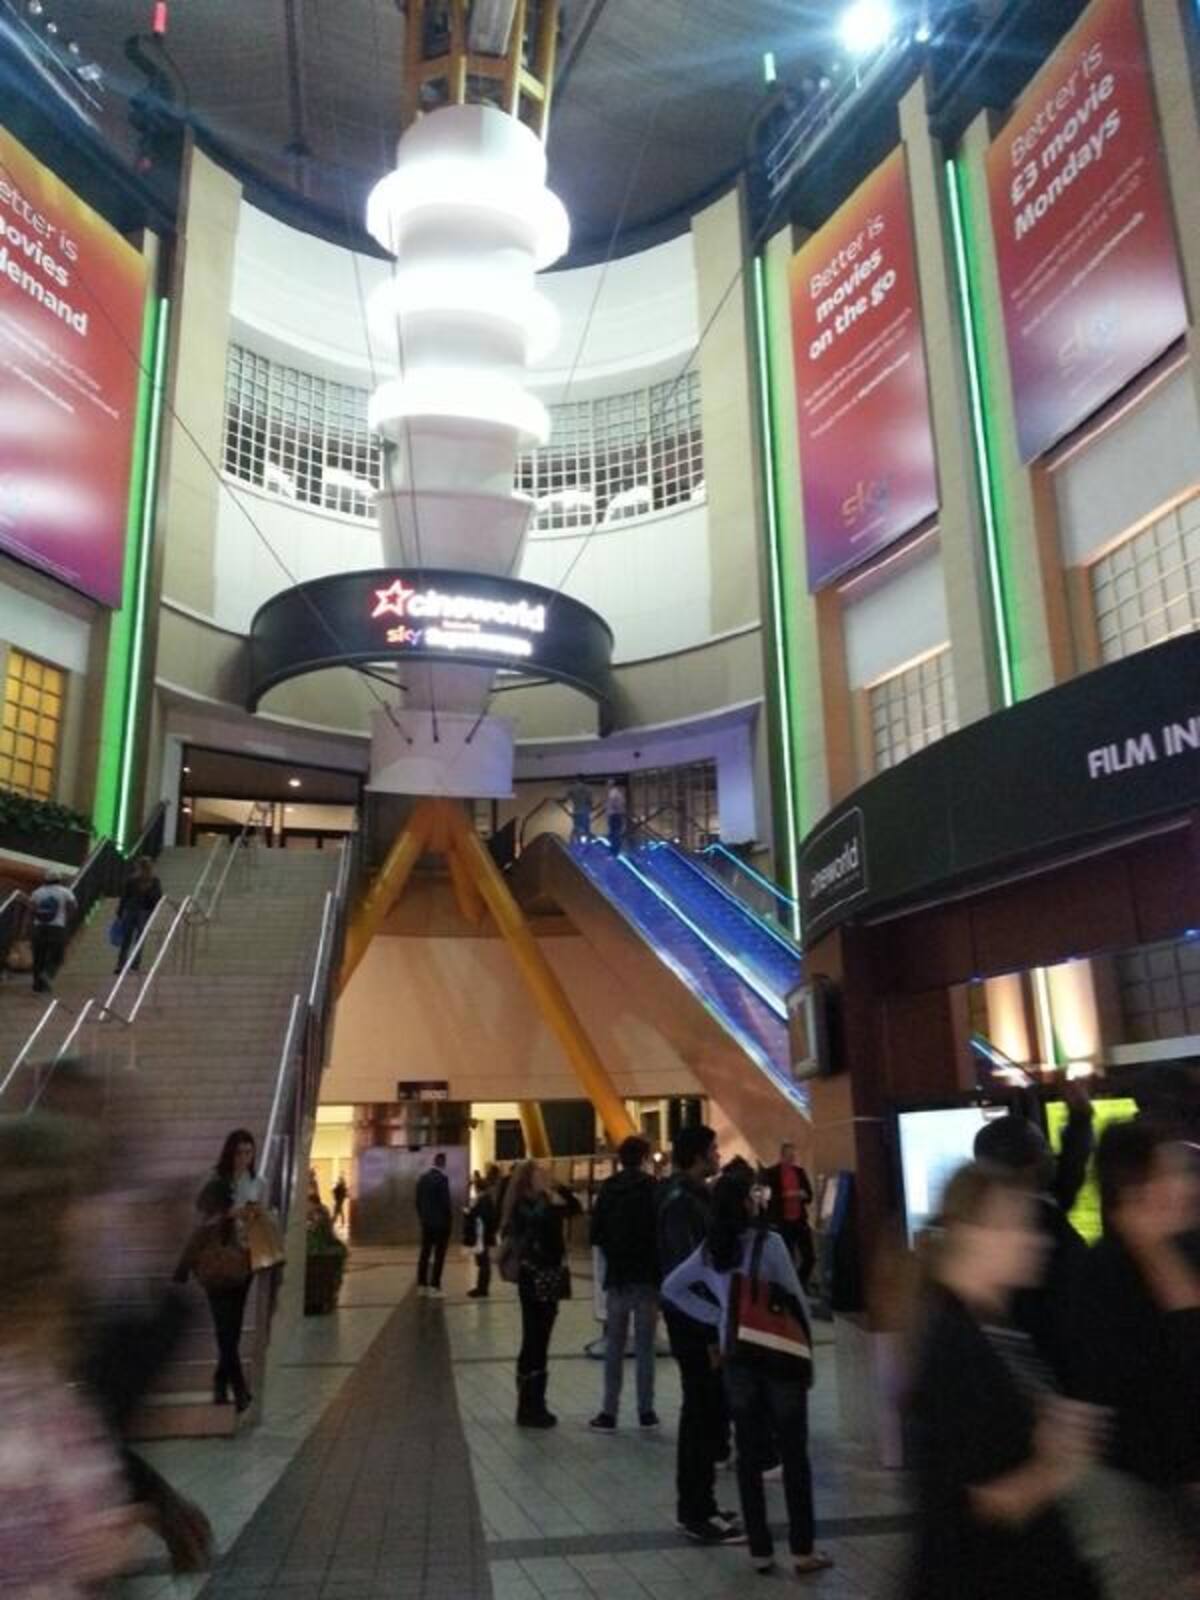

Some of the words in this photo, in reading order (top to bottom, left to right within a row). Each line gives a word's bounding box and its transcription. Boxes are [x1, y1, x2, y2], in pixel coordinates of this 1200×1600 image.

[1011, 160, 1039, 207] £3
[1042, 73, 1115, 169] movie
[1012, 70, 1079, 167] Better
[1082, 42, 1103, 78] is
[1014, 108, 1121, 241] Mondays
[60, 229, 78, 261] is
[810, 232, 865, 299] Better
[868, 214, 885, 239] is
[816, 248, 883, 323] movies
[809, 329, 833, 360] on
[835, 297, 868, 335] the
[871, 269, 897, 307] go
[386, 624, 422, 645] sky
[1087, 732, 1156, 779] FILM
[1162, 715, 1200, 757] IN
